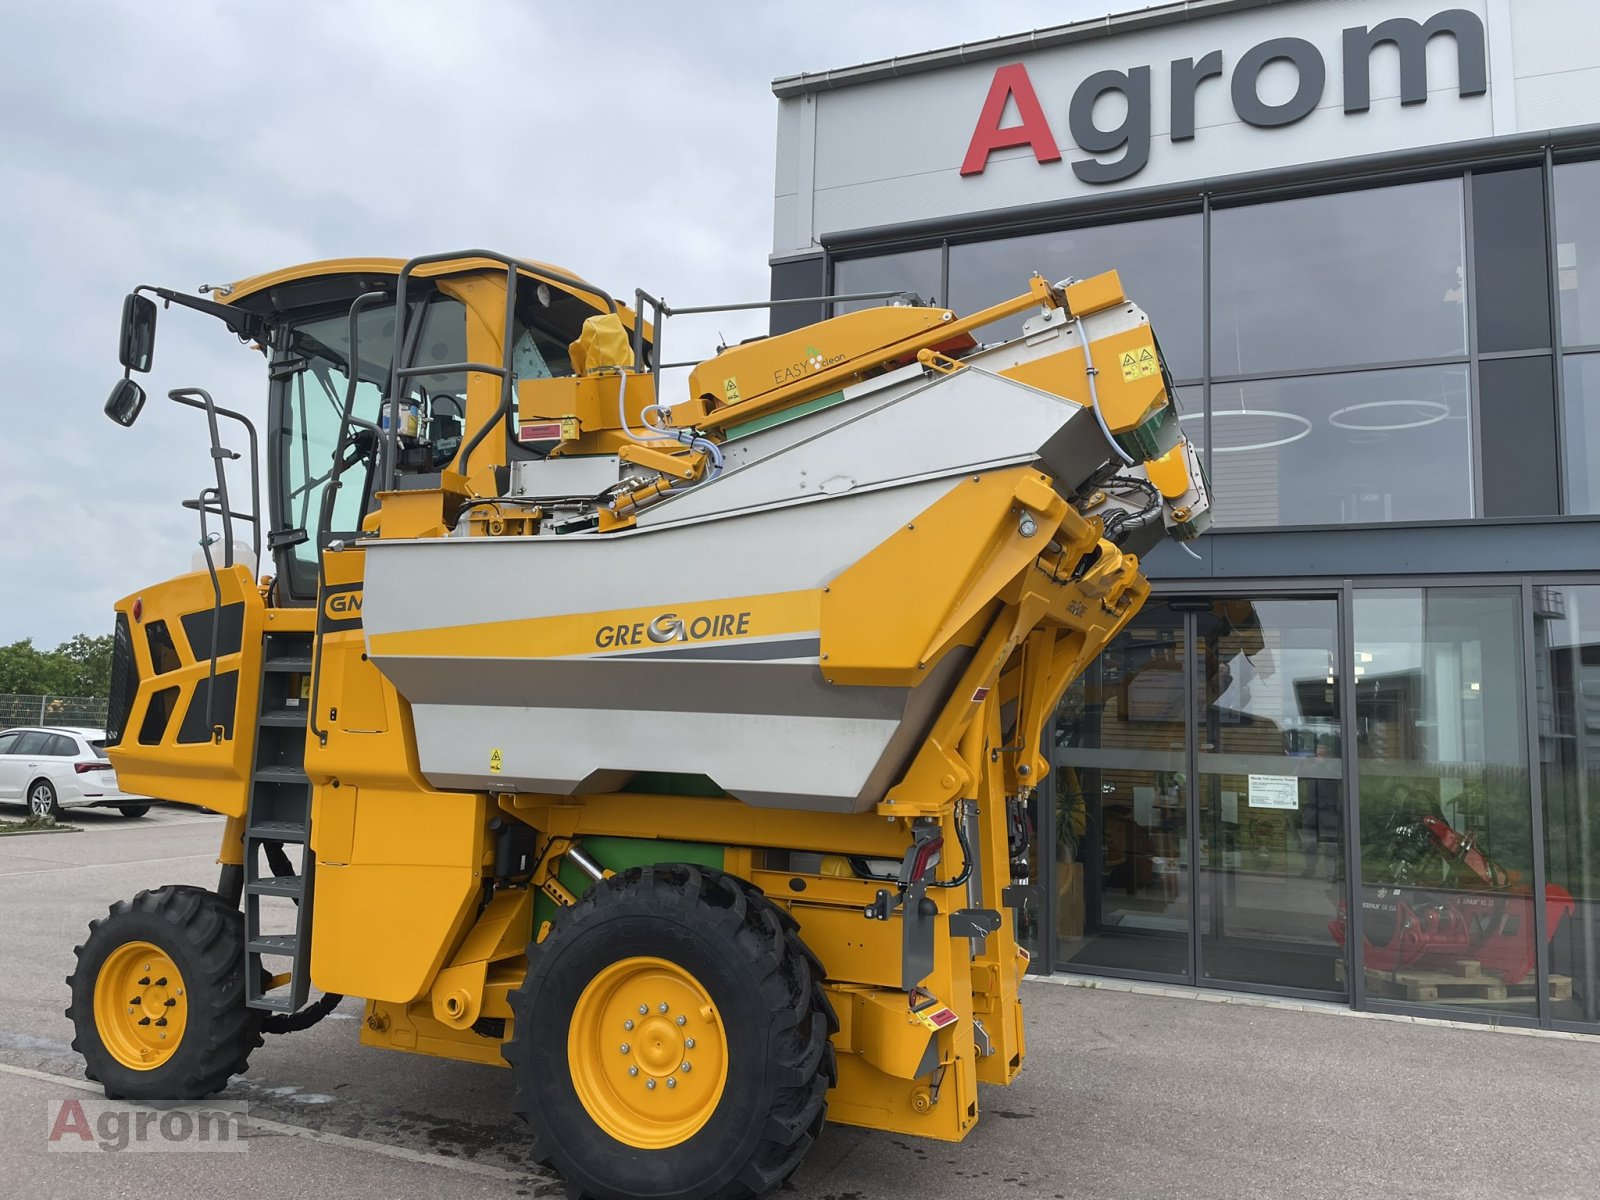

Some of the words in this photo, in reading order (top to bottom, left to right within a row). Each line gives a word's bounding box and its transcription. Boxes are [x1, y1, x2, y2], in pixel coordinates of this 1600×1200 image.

[959, 8, 1487, 185] Agrom
[774, 360, 808, 384] EASY
[822, 353, 846, 367] clean
[595, 612, 751, 648] GREGOIRE
